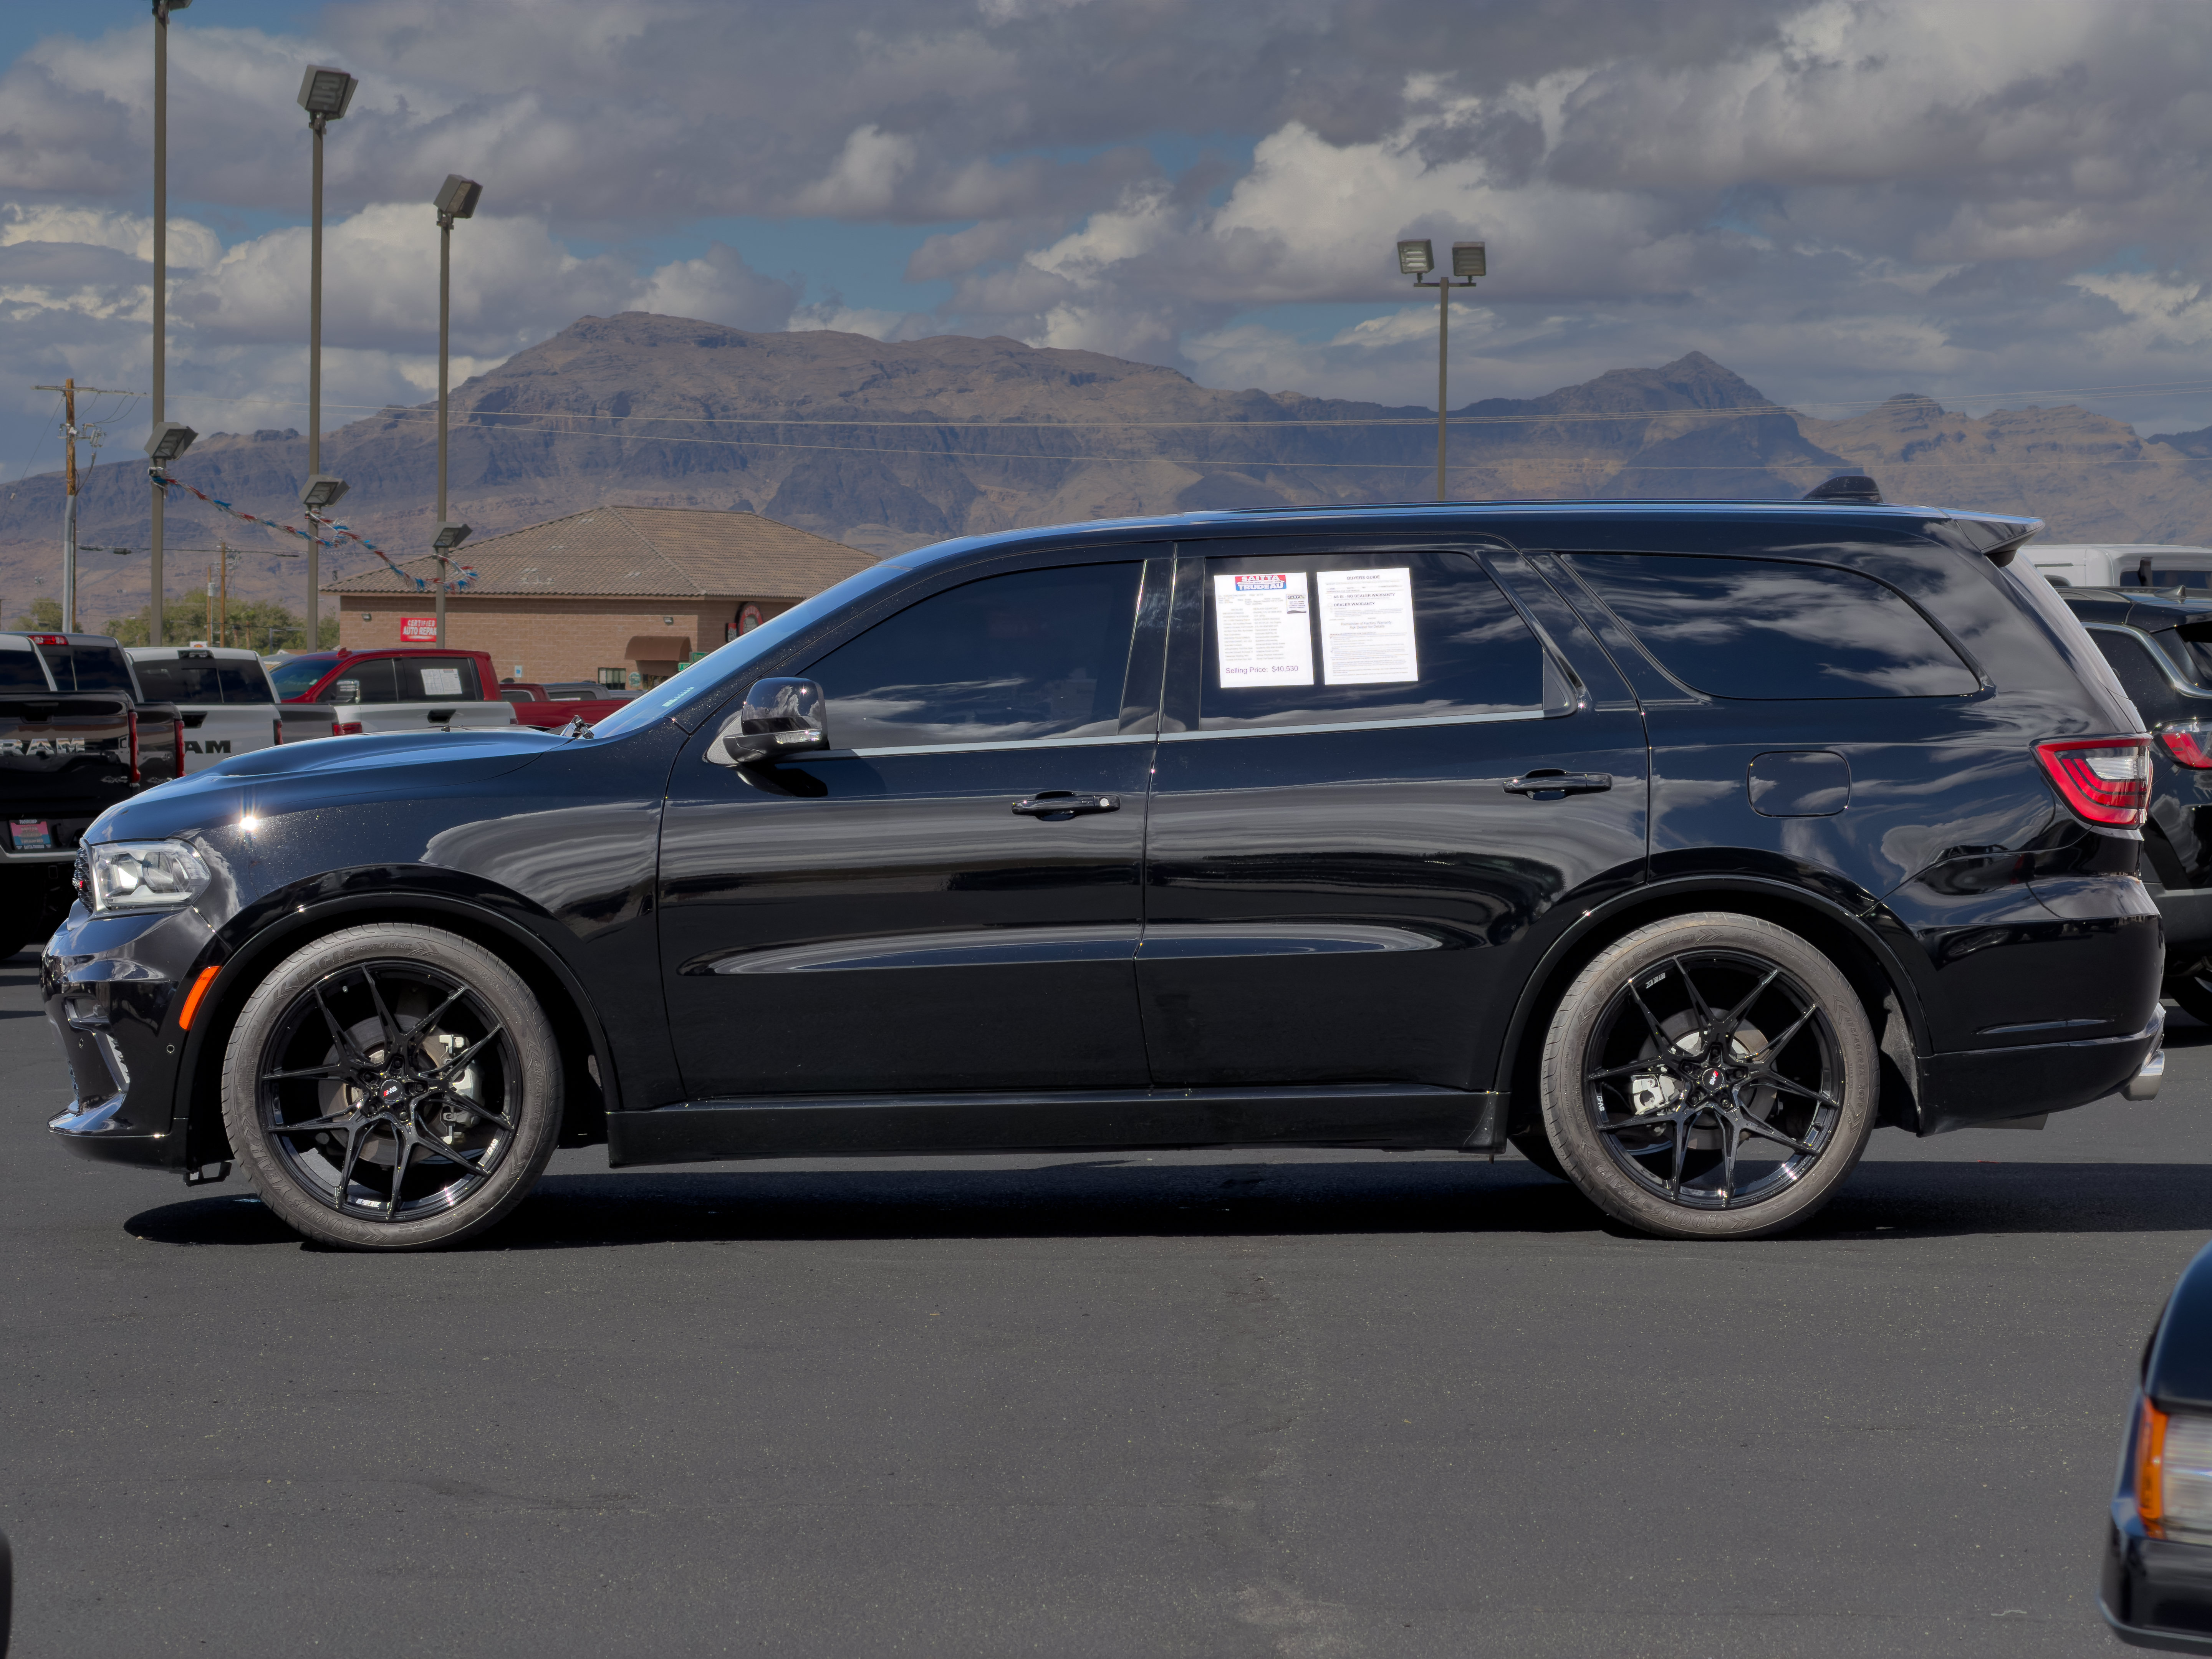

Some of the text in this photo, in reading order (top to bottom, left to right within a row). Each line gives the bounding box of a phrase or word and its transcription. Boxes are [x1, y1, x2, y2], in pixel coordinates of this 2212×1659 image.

[403, 626, 437, 636] AUTO REPAI
[0, 737, 85, 756] RAM
[184, 740, 231, 754] AM
[296, 945, 355, 984] EAGLE
[1594, 952, 1645, 999] EAGLE
[1579, 1031, 1588, 1046] OUTSIDE
